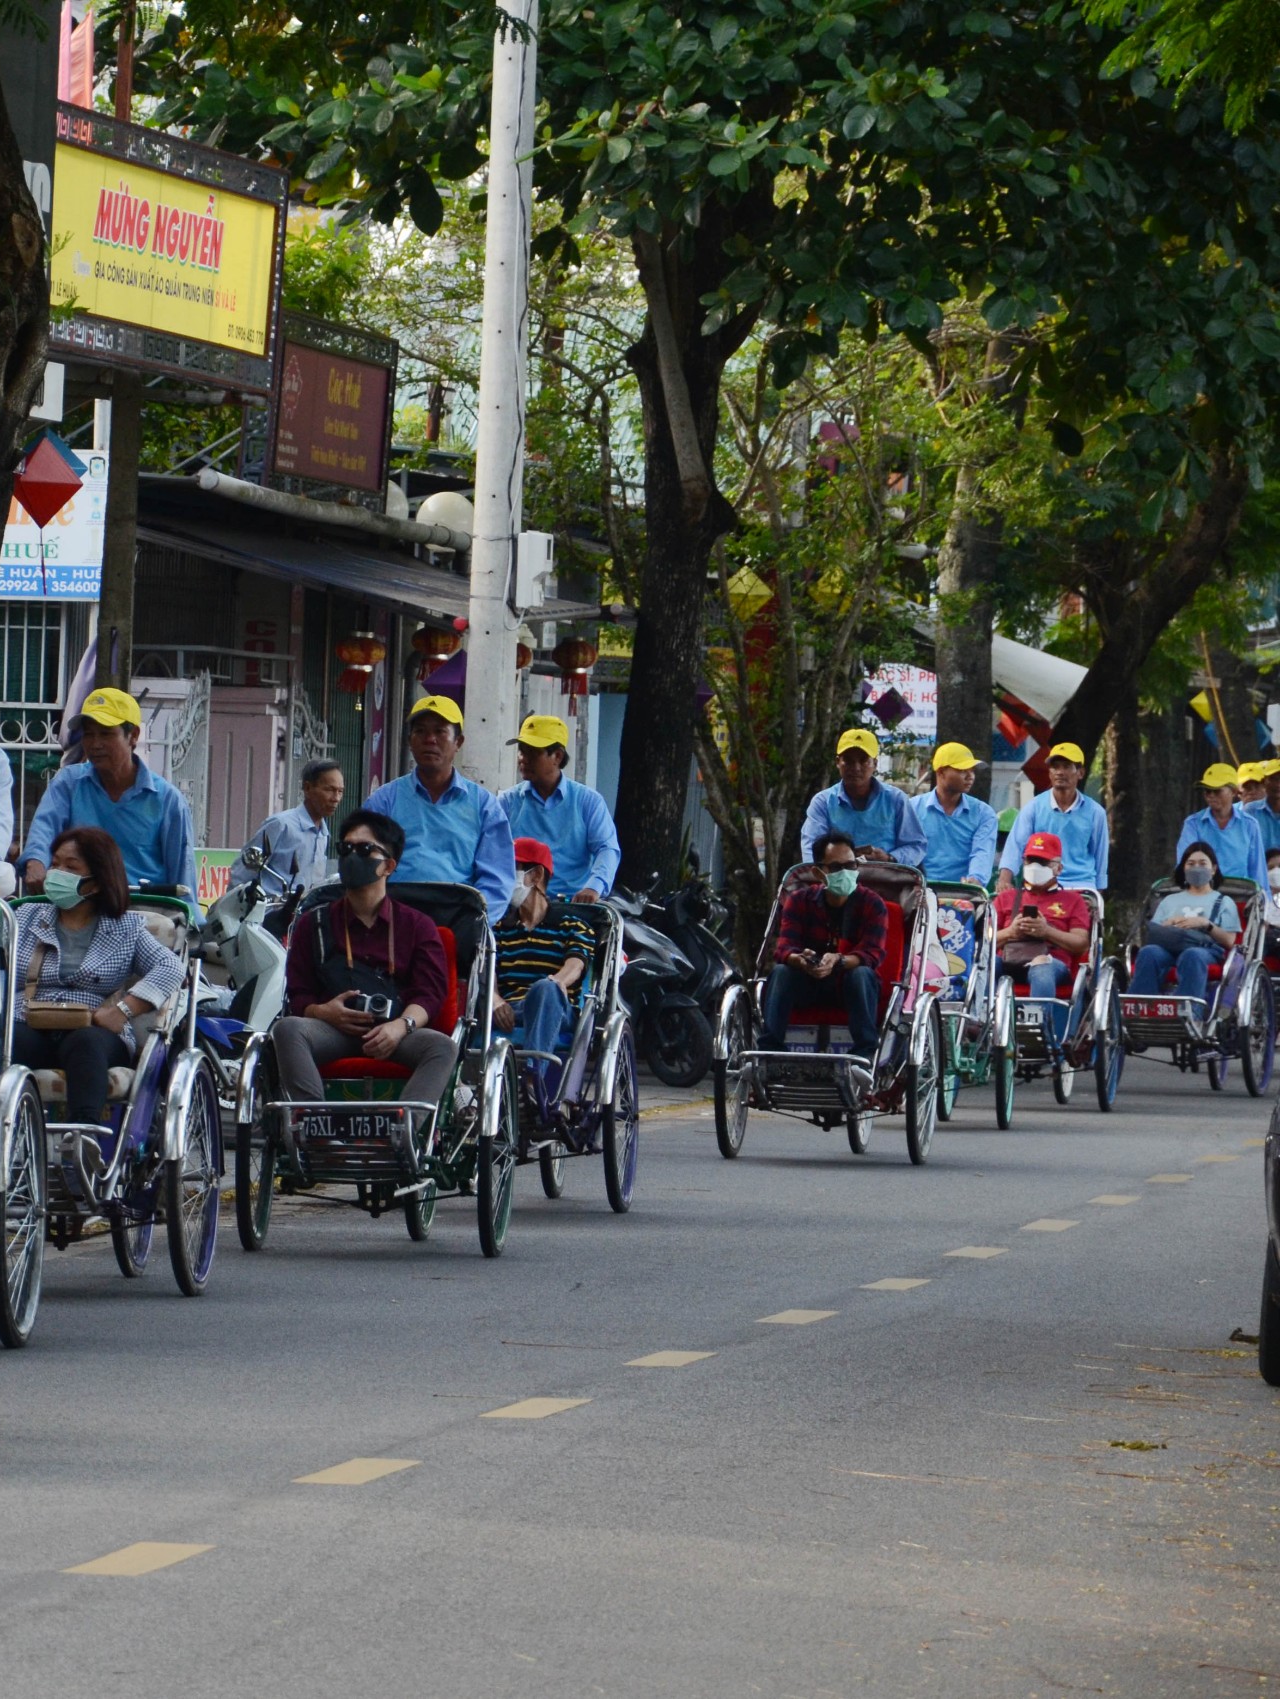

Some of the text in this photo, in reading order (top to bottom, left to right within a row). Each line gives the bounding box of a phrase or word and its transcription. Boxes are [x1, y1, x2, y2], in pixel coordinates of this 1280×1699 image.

[94, 181, 150, 254] MỪNG
[95, 261, 105, 279] GIA
[107, 260, 125, 285] CÔNG
[2, 537, 60, 559] HUẾ
[9, 566, 56, 579] HUÂN
[1157, 1004, 1174, 1016] 363
[303, 1116, 336, 1136] 75XL
[349, 1116, 370, 1136] 175
